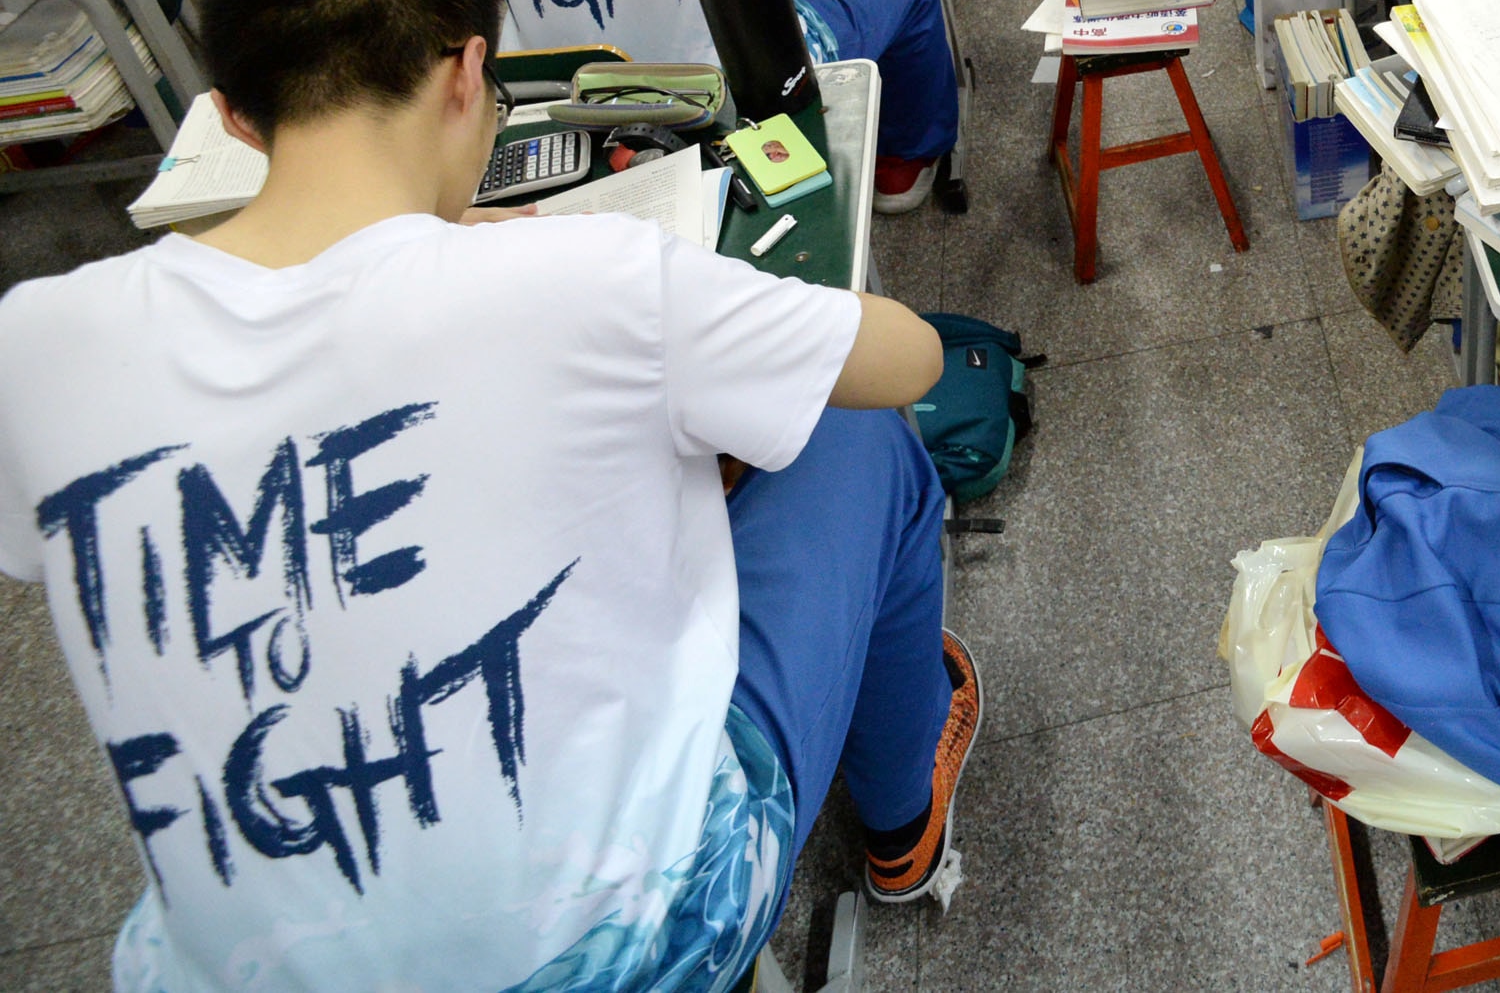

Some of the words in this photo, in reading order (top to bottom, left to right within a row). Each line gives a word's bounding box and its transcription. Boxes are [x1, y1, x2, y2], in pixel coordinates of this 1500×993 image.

[1072, 26, 1108, 38] 高中
[37, 401, 440, 703] TIME
[105, 557, 582, 909] FIGHT
[198, 607, 312, 713] TO
